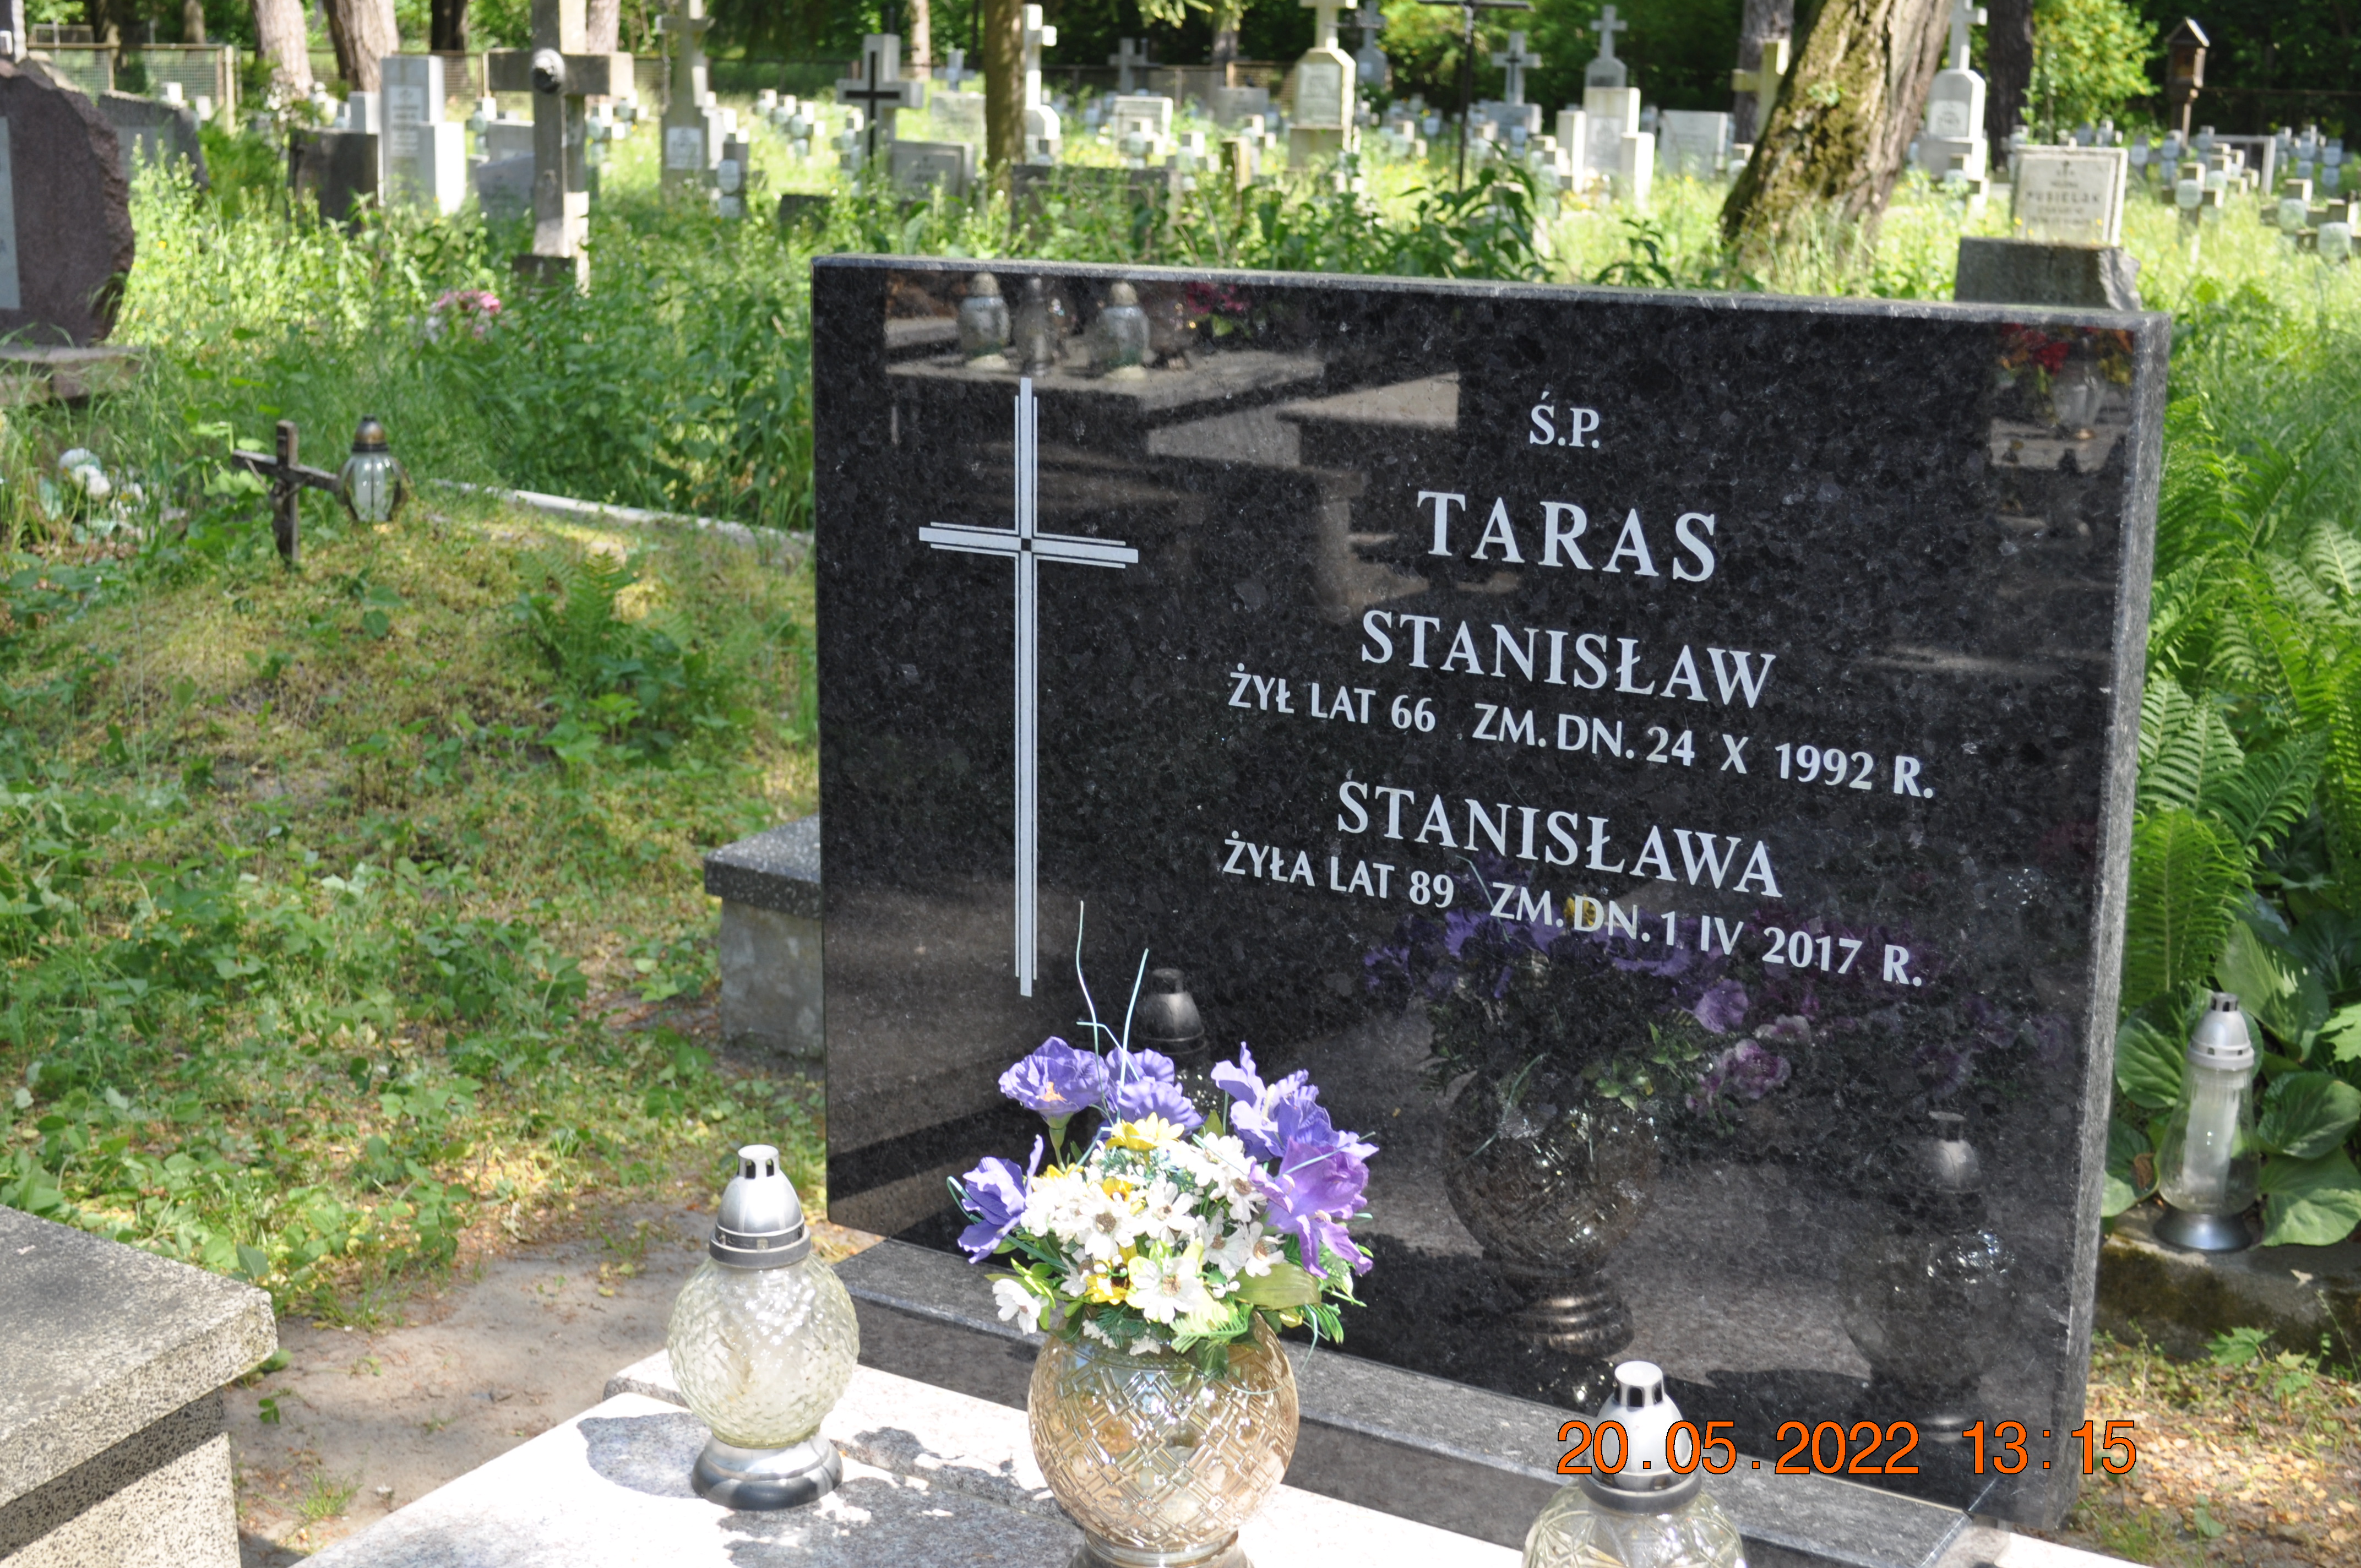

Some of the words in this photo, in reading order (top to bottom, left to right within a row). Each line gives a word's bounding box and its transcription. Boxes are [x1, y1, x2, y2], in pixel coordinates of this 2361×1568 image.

[1529, 391, 1600, 448] Ś.P.
[1416, 491, 1715, 582] TARAS
[1361, 610, 1776, 709] STANISŁAW
[1228, 663, 1294, 714] ŻYŁ
[1311, 682, 1376, 723] LAT
[1391, 694, 1435, 732] 66
[1472, 703, 1546, 747] ZM.
[1558, 714, 1634, 759] DN.
[1646, 726, 1695, 766] 24
[1720, 734, 1749, 774] X
[1775, 743, 1874, 790] 1992
[1894, 755, 1933, 798] R.
[1338, 781, 1783, 898] STANISŁAWA
[1222, 831, 1315, 886] ŻYŁA
[1330, 856, 1395, 899] LAT
[1409, 870, 1454, 908] 89
[1490, 882, 1564, 928] ZM.
[1574, 895, 1650, 942] DN.
[1661, 911, 1675, 946] 1
[1700, 915, 1744, 955] IV
[1762, 927, 1863, 974] 2017
[1883, 944, 1922, 987] R.
